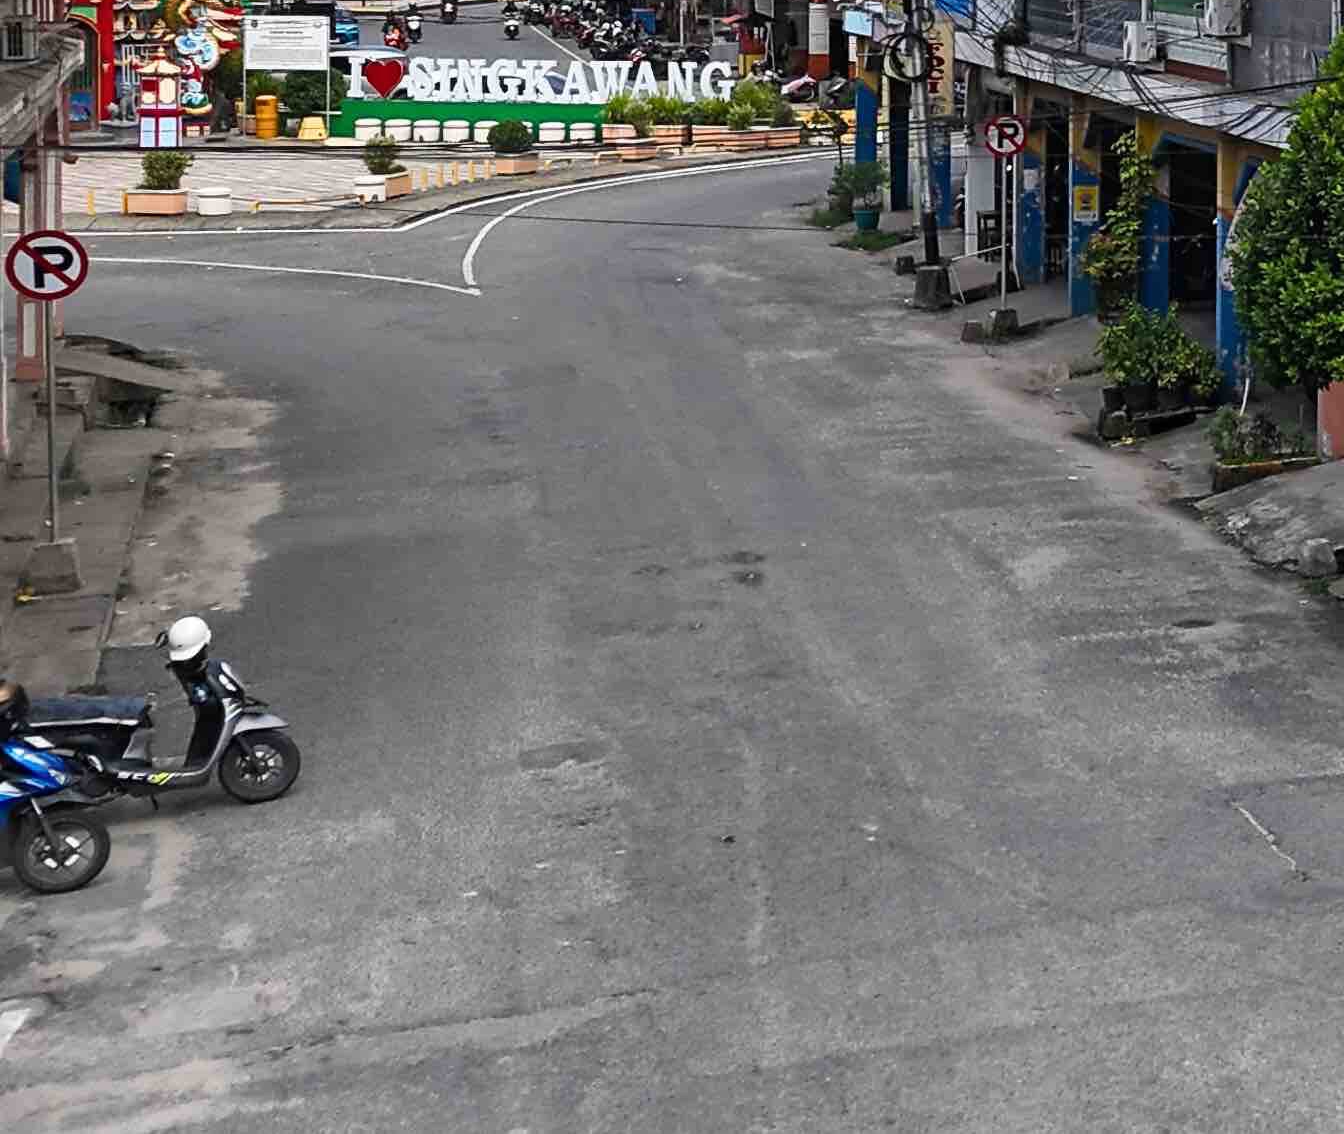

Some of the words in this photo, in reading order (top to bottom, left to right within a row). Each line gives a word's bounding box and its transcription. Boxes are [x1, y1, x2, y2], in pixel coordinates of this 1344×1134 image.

[409, 56, 736, 102] SINGKAWANG
[998, 123, 1019, 148] P
[33, 246, 74, 288] P
